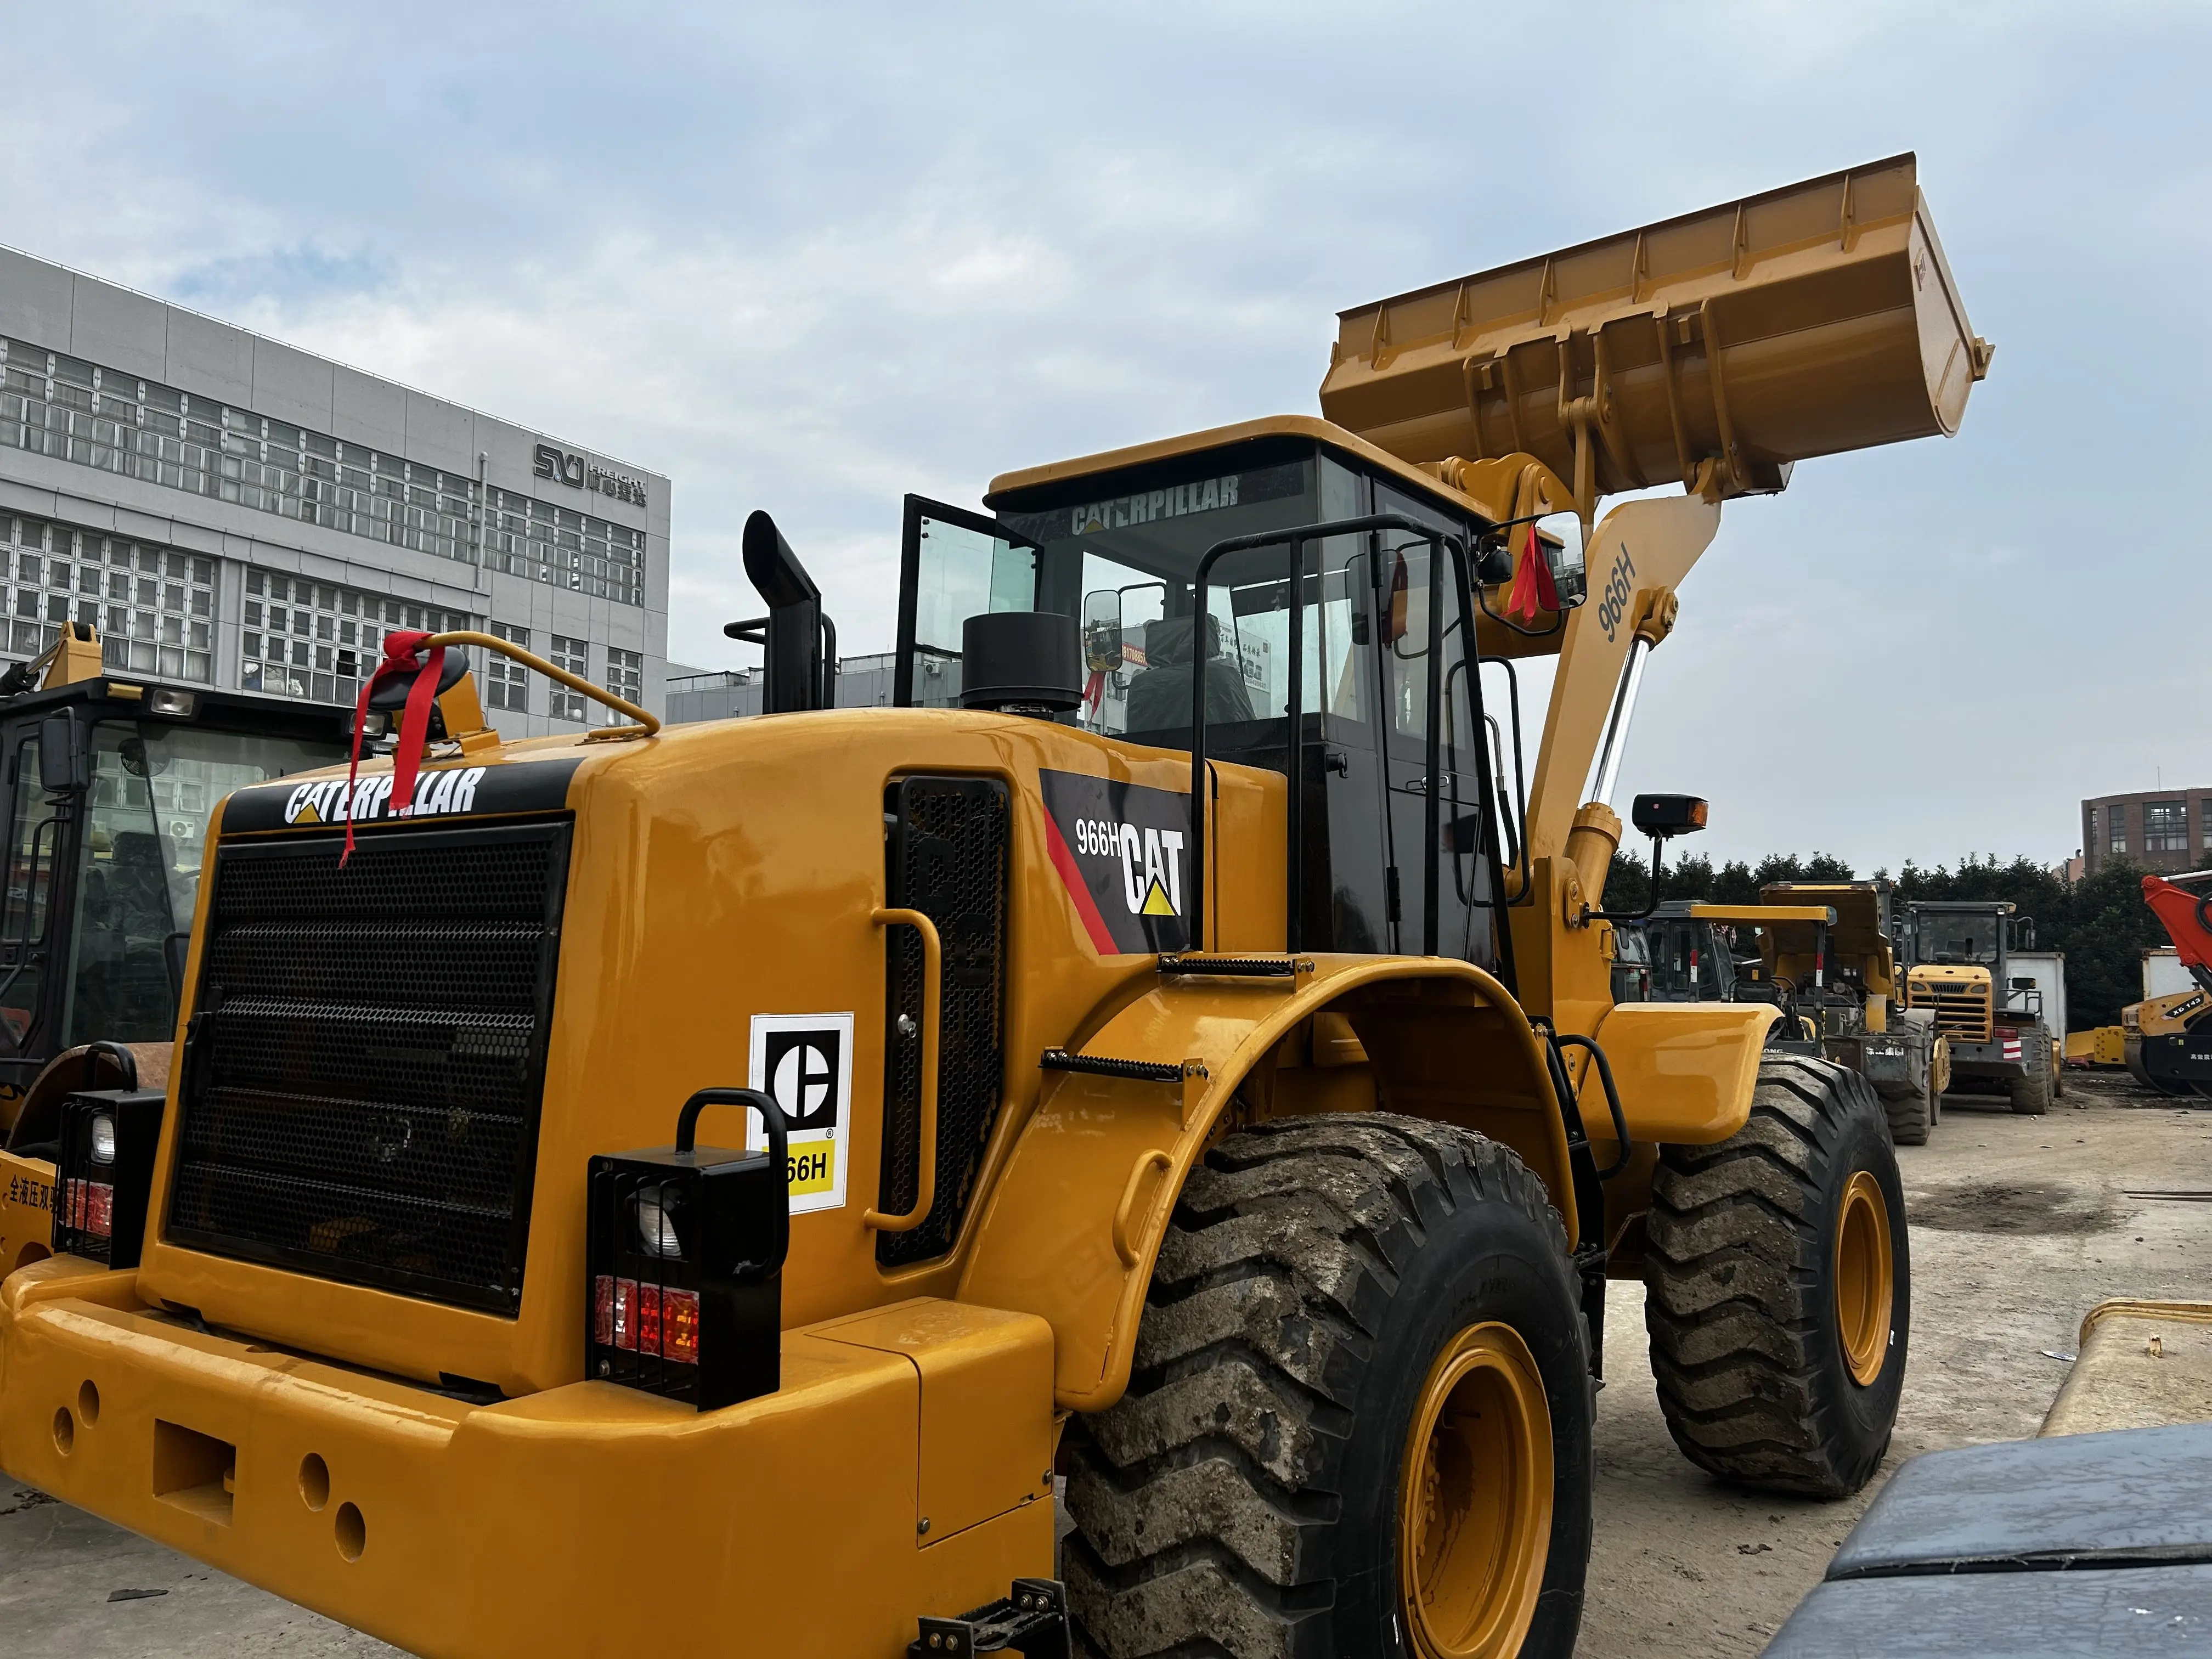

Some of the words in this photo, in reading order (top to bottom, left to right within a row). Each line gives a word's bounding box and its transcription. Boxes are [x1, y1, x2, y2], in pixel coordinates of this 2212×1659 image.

[588, 463, 646, 488] FREIGHT
[1071, 476, 1239, 535] CATERPILLAR
[1598, 540, 1636, 644] 966H
[284, 767, 487, 824] CATERPLAR
[1076, 818, 1121, 857] 966H
[1119, 823, 1183, 916] CAT
[2172, 1007, 2185, 1016] XD
[2186, 997, 2201, 1008] 143
[787, 1152, 827, 1183] 66H
